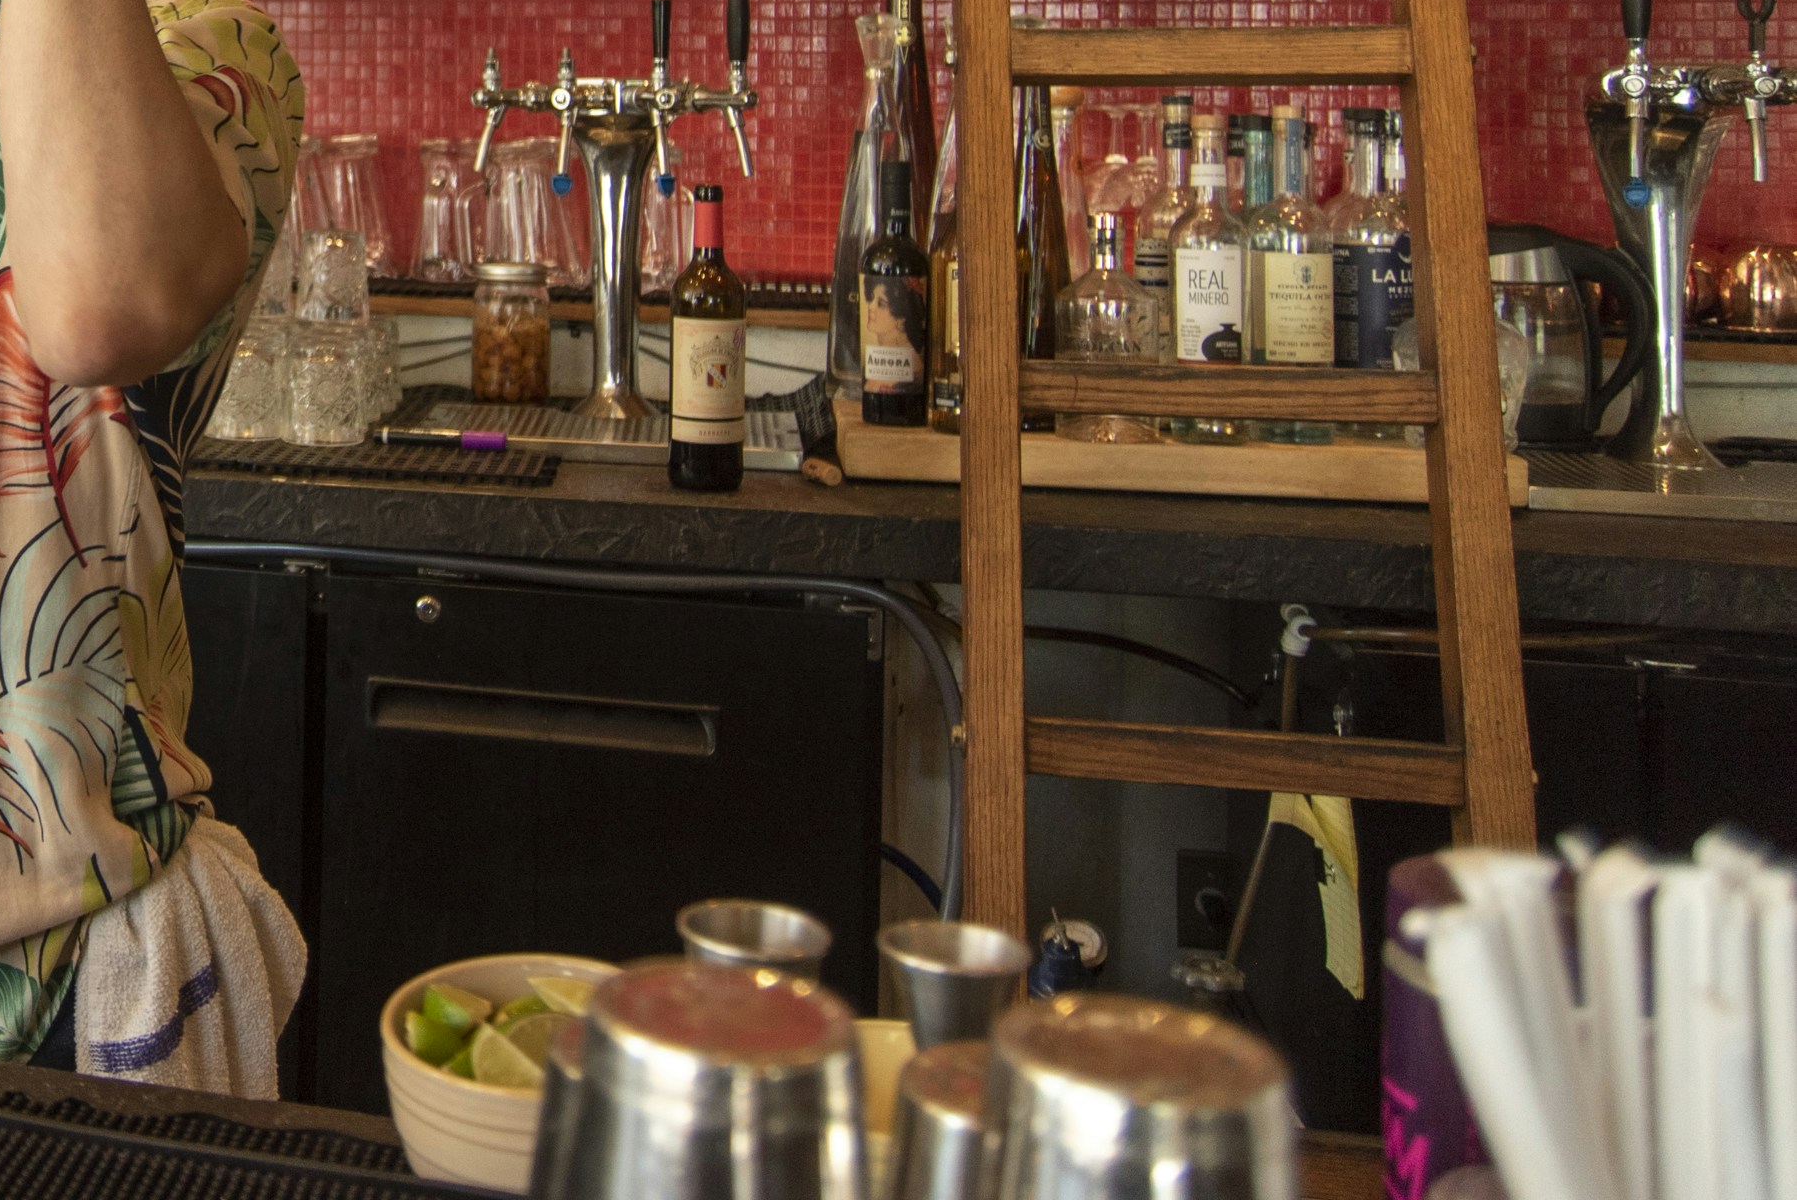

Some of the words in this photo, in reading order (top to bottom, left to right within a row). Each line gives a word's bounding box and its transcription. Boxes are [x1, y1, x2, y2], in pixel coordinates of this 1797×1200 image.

[1188, 269, 1229, 290] REAL
[1371, 269, 1396, 283] LA
[1188, 290, 1229, 306] MINERO
[1269, 292, 1311, 302] TEQUILA
[868, 354, 911, 367] AURORA
